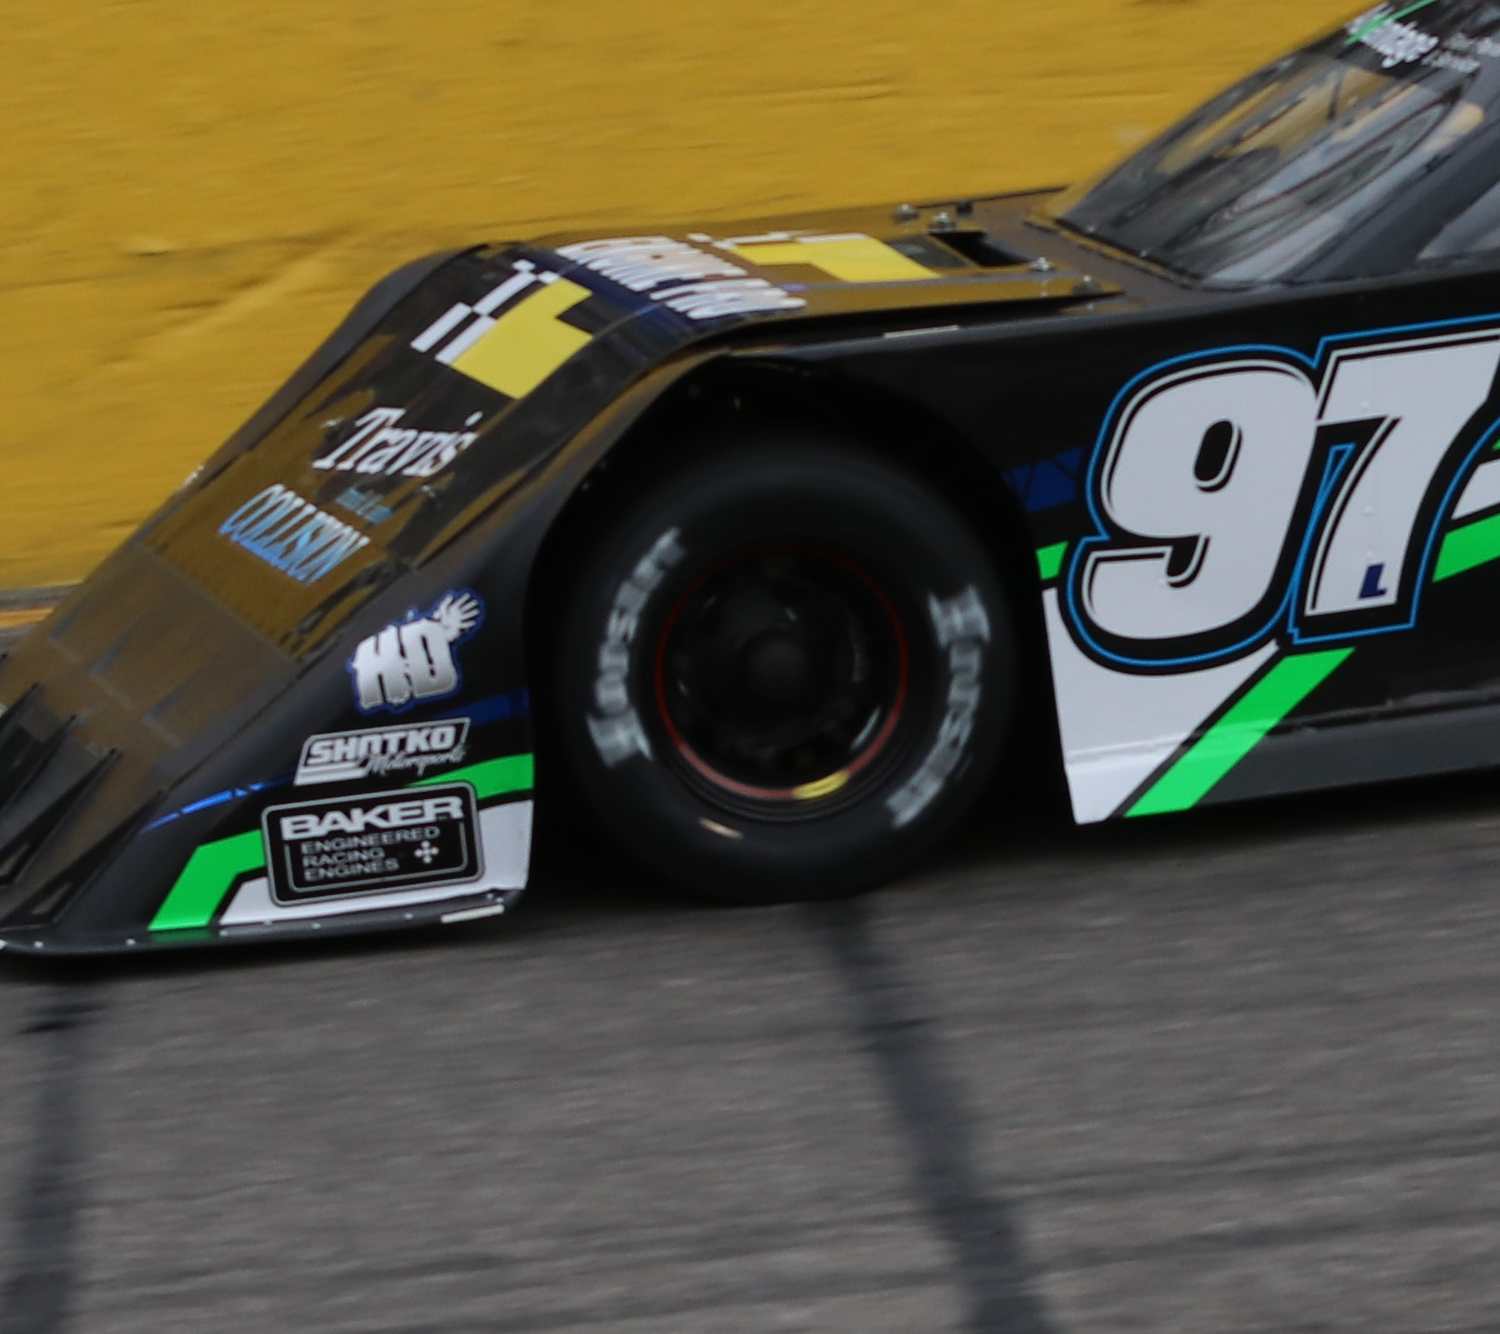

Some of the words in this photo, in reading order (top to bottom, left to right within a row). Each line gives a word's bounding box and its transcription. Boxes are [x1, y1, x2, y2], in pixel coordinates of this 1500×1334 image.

[312, 407, 483, 478] Travis
[218, 483, 371, 586] COLLISION
[280, 796, 464, 841] BAKER
[301, 825, 441, 853] ENGINEERED
[302, 847, 386, 868] RACING
[304, 858, 400, 883] ENGINES
